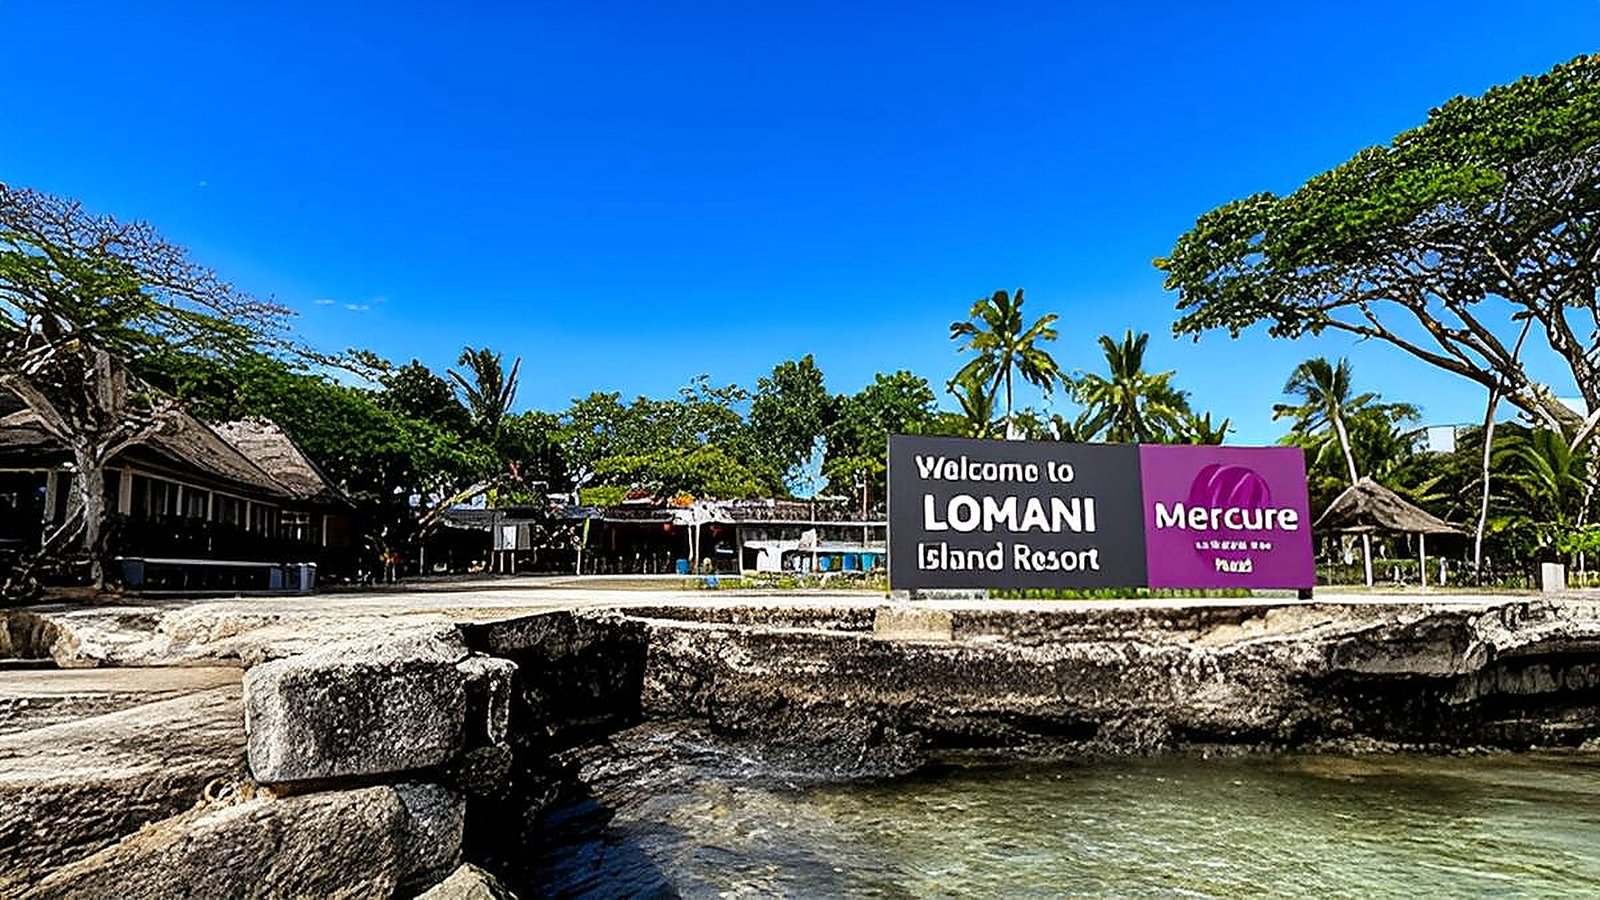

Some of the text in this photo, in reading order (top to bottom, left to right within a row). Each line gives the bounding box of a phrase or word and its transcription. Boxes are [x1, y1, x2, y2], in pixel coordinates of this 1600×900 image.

[915, 455, 1074, 483] Welcome to
[923, 494, 1097, 533] LOMANI
[1155, 502, 1299, 531] Mercure
[918, 541, 1100, 571] Island Resort
